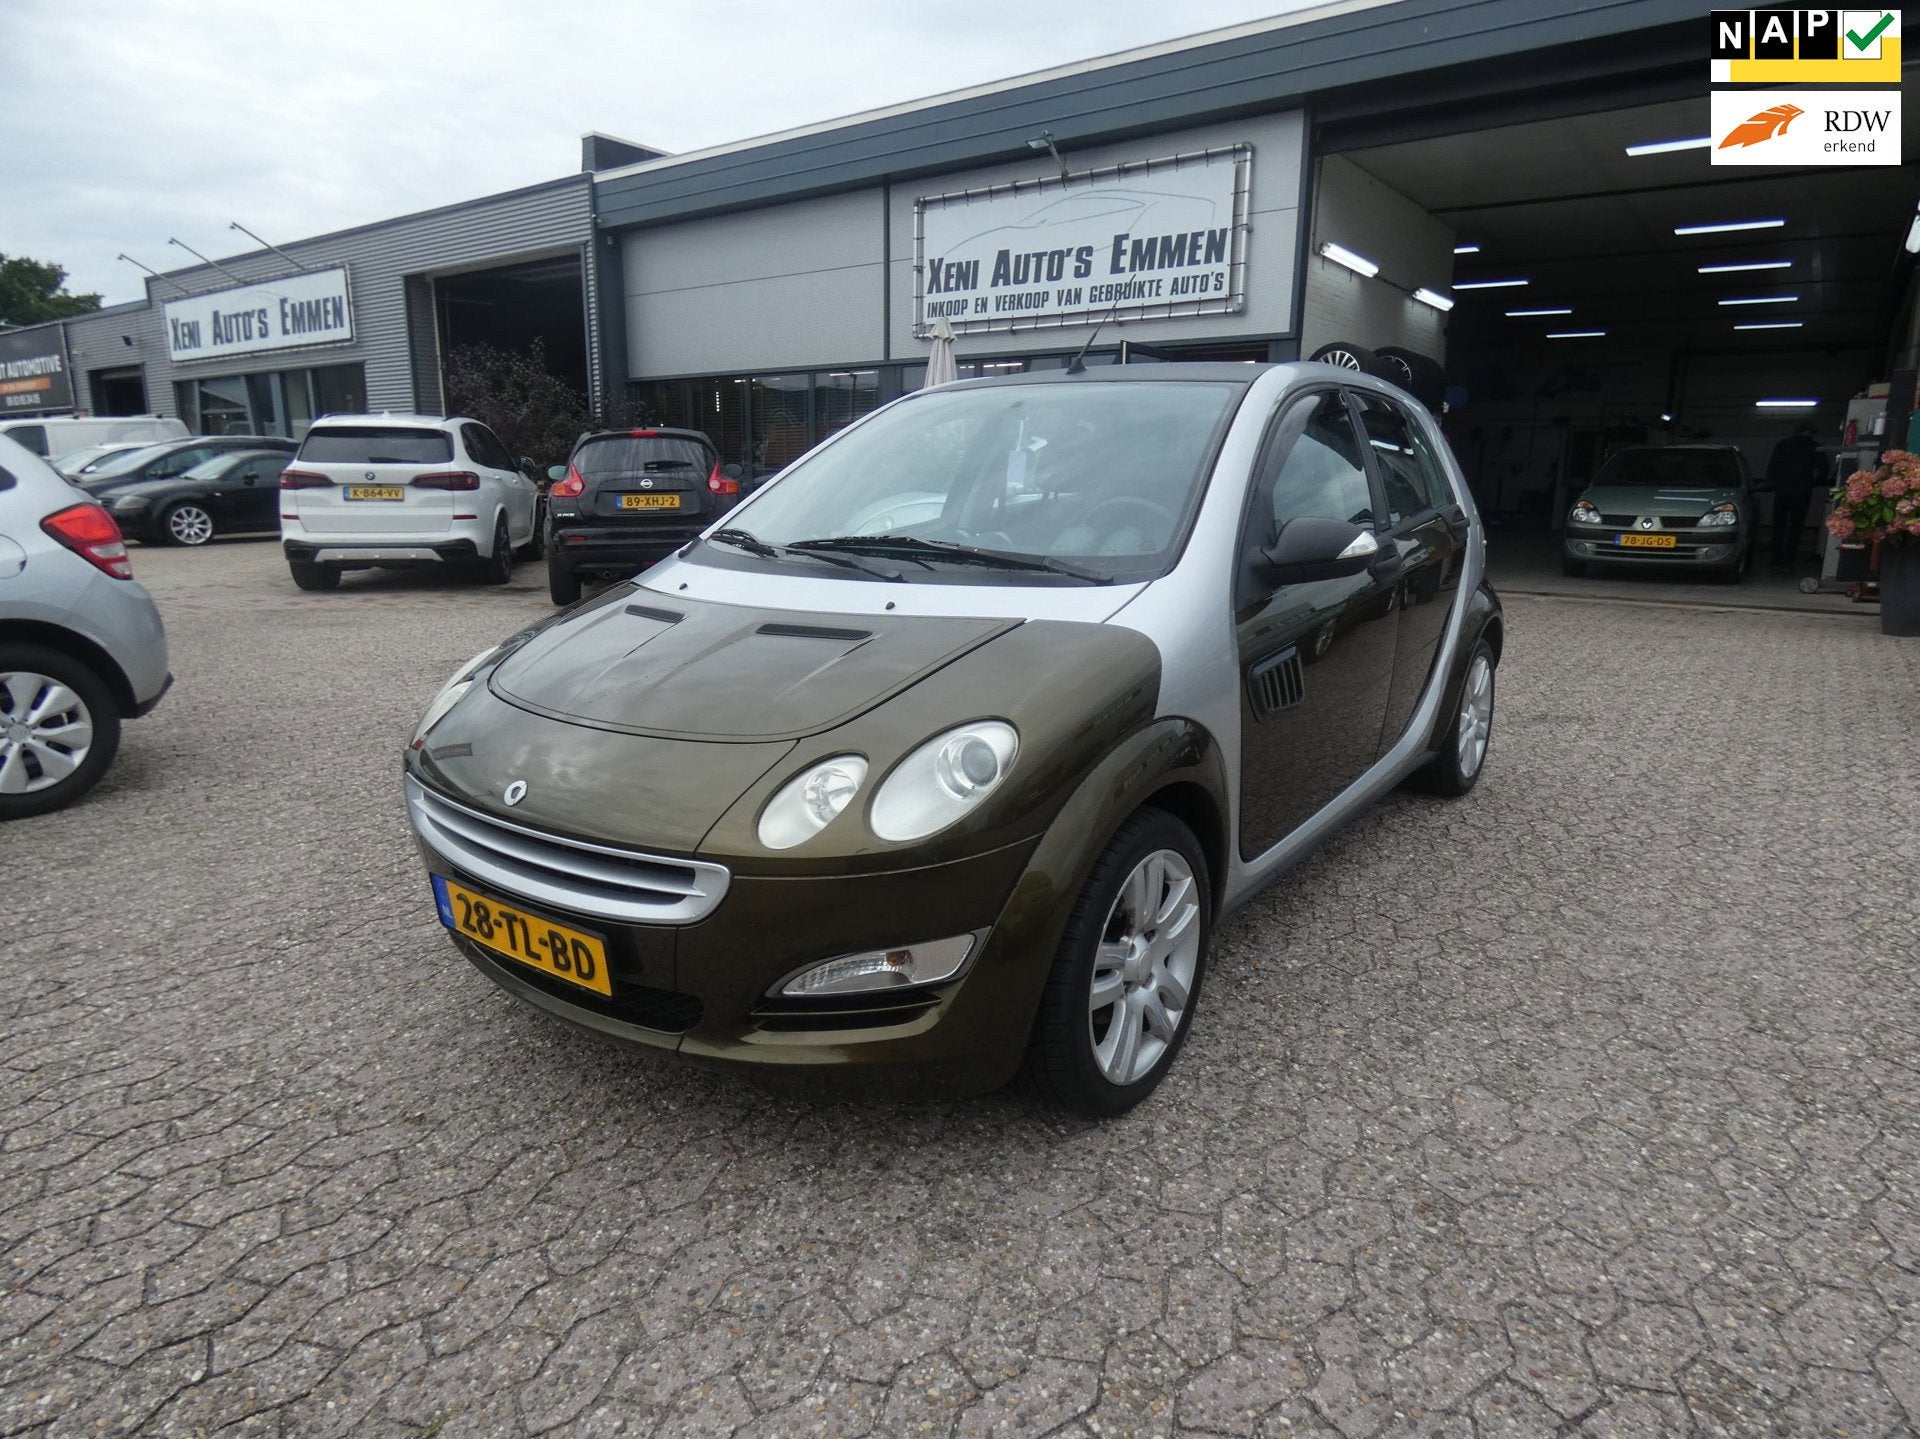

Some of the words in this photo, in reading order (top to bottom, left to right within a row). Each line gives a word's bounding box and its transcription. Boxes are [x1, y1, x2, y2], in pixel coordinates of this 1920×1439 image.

[927, 258, 980, 294] XENI
[990, 245, 1094, 288] AUTO'S
[1110, 228, 1228, 275] EMMEN
[927, 298, 968, 319] INKOOP
[974, 296, 989, 313] EN
[994, 290, 1049, 312] VERKOOP
[1056, 287, 1083, 306] VAN
[1089, 278, 1162, 303] GEBRUIKTE
[1169, 271, 1225, 296] AUTO'S
[171, 317, 201, 351] XENI
[213, 307, 269, 345] AUTO'S
[280, 295, 345, 336] EMMEN
[353, 488, 400, 498] K-864-VV
[626, 496, 676, 507] 89-XHJ-2
[1624, 536, 1672, 546] 78-JG-DS
[456, 893, 595, 980] 28-TL-BD
